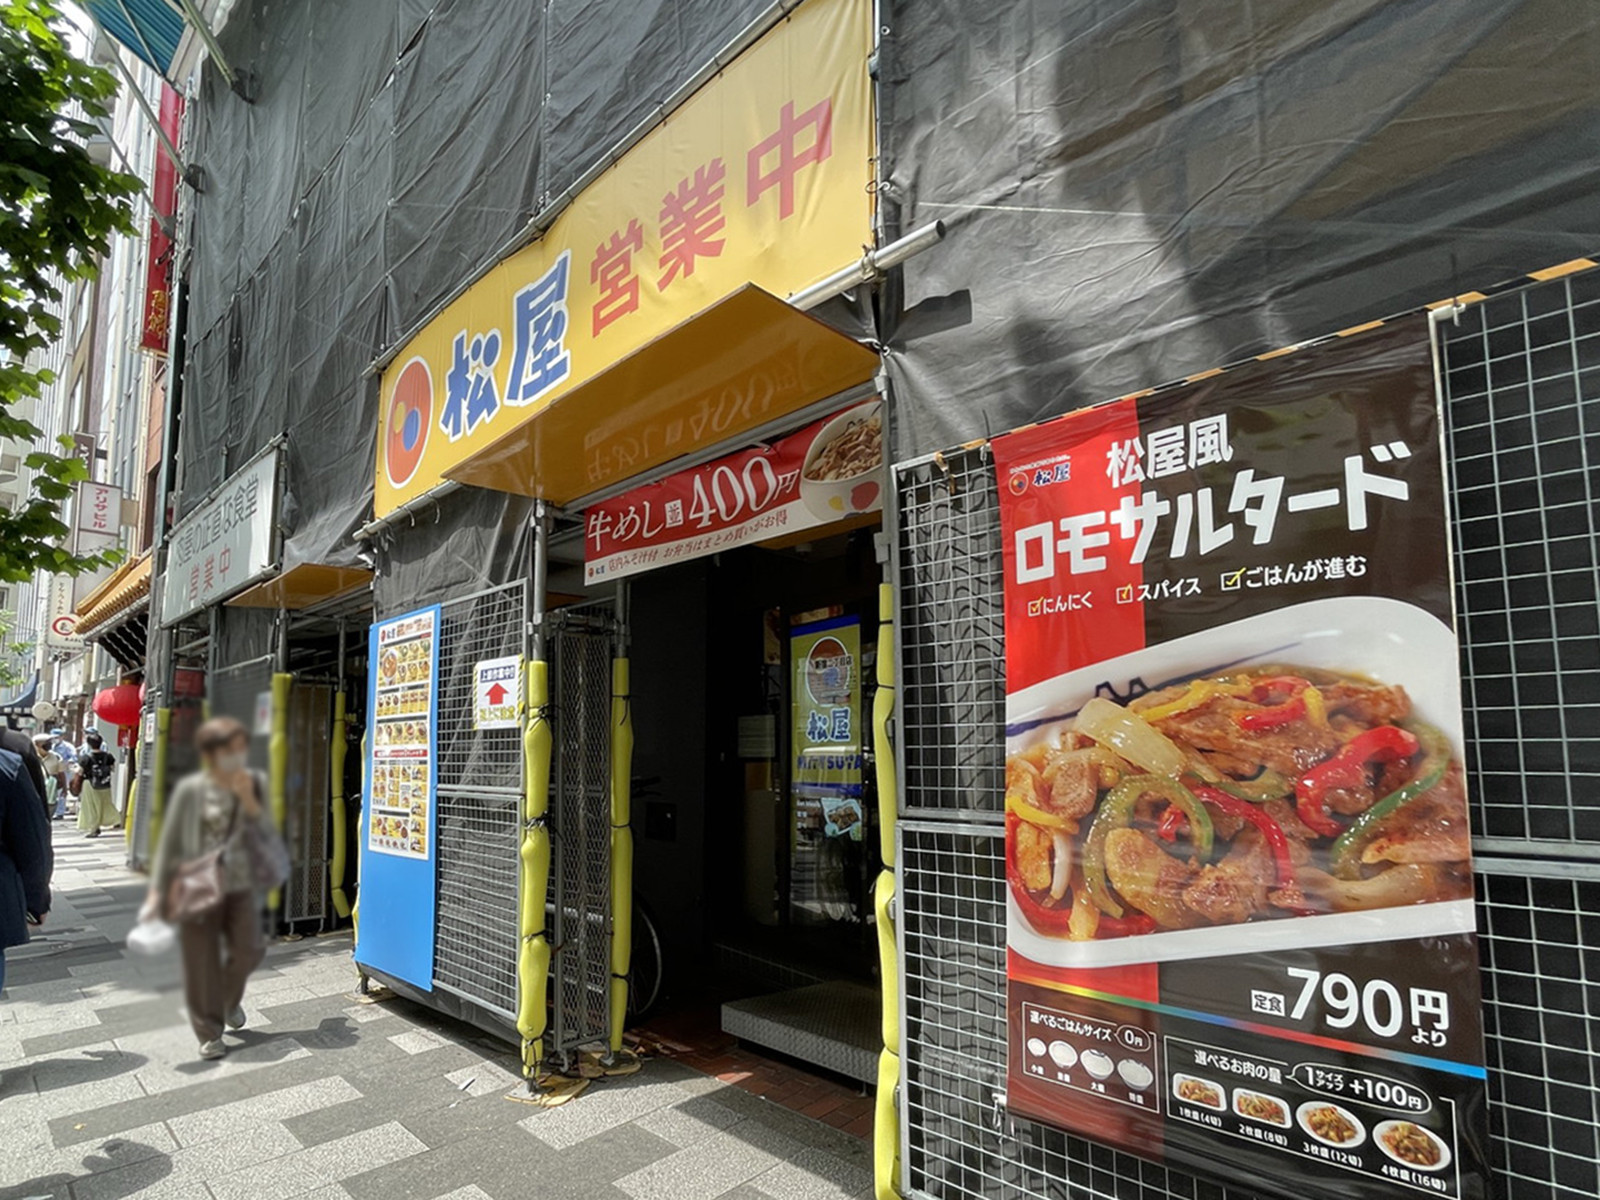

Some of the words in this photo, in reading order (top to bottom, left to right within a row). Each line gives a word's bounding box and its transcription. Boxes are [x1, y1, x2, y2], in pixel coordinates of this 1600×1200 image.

[440, 249, 570, 441] 松屋
[590, 97, 832, 337] 営業中
[1106, 413, 1234, 488] 松屋風
[1032, 462, 1071, 487] 松屋
[588, 501, 665, 552] 牛めし
[689, 456, 800, 529] 400円
[1014, 440, 1413, 584] ロモサルタード
[189, 544, 232, 601] 営業中
[1137, 577, 1202, 602] スパイス
[1245, 555, 1367, 588] ごはんが進む
[1042, 591, 1093, 614] にんにく
[806, 707, 850, 743] 松屋
[1253, 992, 1285, 1016] 定食
[1287, 967, 1449, 1038] 790円
[1030, 1009, 1113, 1043] 選べるごはんサイズ
[1124, 1029, 1144, 1048] 0円
[1411, 1028, 1447, 1048] より
[1194, 1049, 1283, 1085] 選べるお肉の量
[1350, 1078, 1422, 1110] +100円
